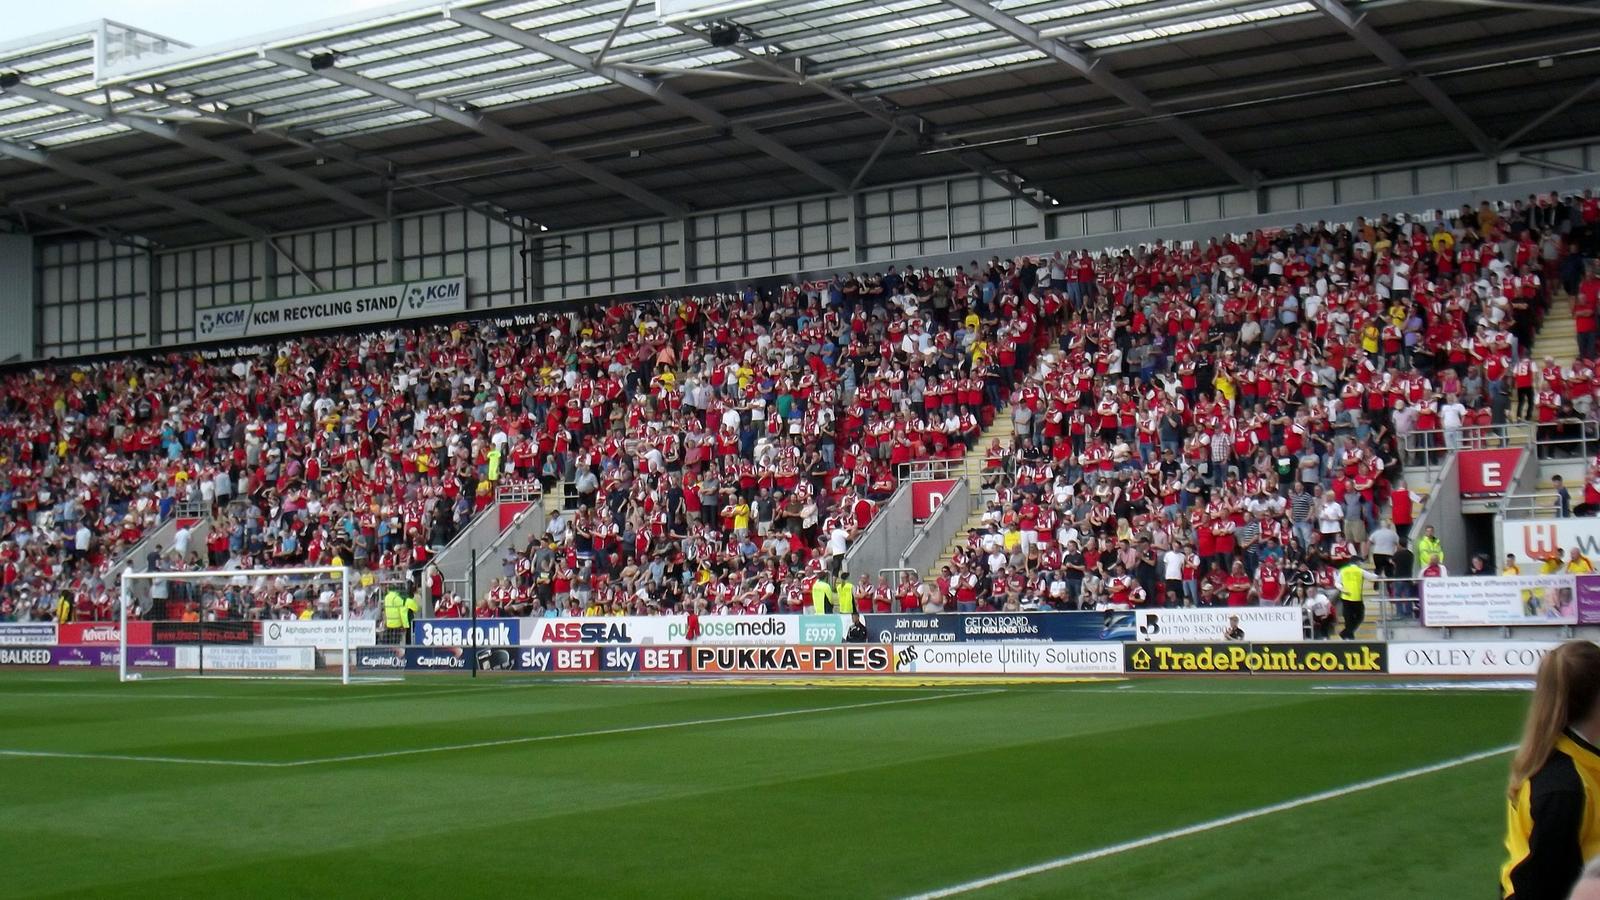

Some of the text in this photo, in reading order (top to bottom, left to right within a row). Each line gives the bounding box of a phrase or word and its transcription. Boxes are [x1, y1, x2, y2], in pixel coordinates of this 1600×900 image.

[426, 283, 460, 300] KCM
[216, 309, 245, 325] KCM
[254, 296, 397, 325] KCM RECYCLING STAND
[515, 314, 535, 325] York
[219, 347, 236, 358] York
[1482, 462, 1502, 487] E
[895, 618, 939, 629] Join now at
[964, 616, 1028, 627] GET ON BOARD
[1160, 612, 1214, 624] CHAMBER
[1240, 611, 1296, 622] OMMERCE
[82, 628, 121, 641] Advertise
[338, 625, 373, 634] Mchinery
[422, 622, 510, 646] 3aaa.co.uk
[541, 622, 632, 643] AESSEAL
[668, 617, 786, 641] puosemedia
[805, 627, 836, 642] £9.99
[965, 625, 1039, 634] EAST MIDLANDS TRAINS
[1161, 626, 1190, 635] 01709
[1, 649, 51, 664] BALREED
[521, 647, 595, 671] sky BET
[606, 647, 683, 671] sky BET
[697, 647, 888, 671] PUKKA-PIES
[923, 647, 1117, 667] Complete Utility Solutions
[1155, 645, 1380, 671] TradePoint.co.uk
[1405, 649, 1475, 666] OXLEY
[1482, 649, 1497, 666] &
